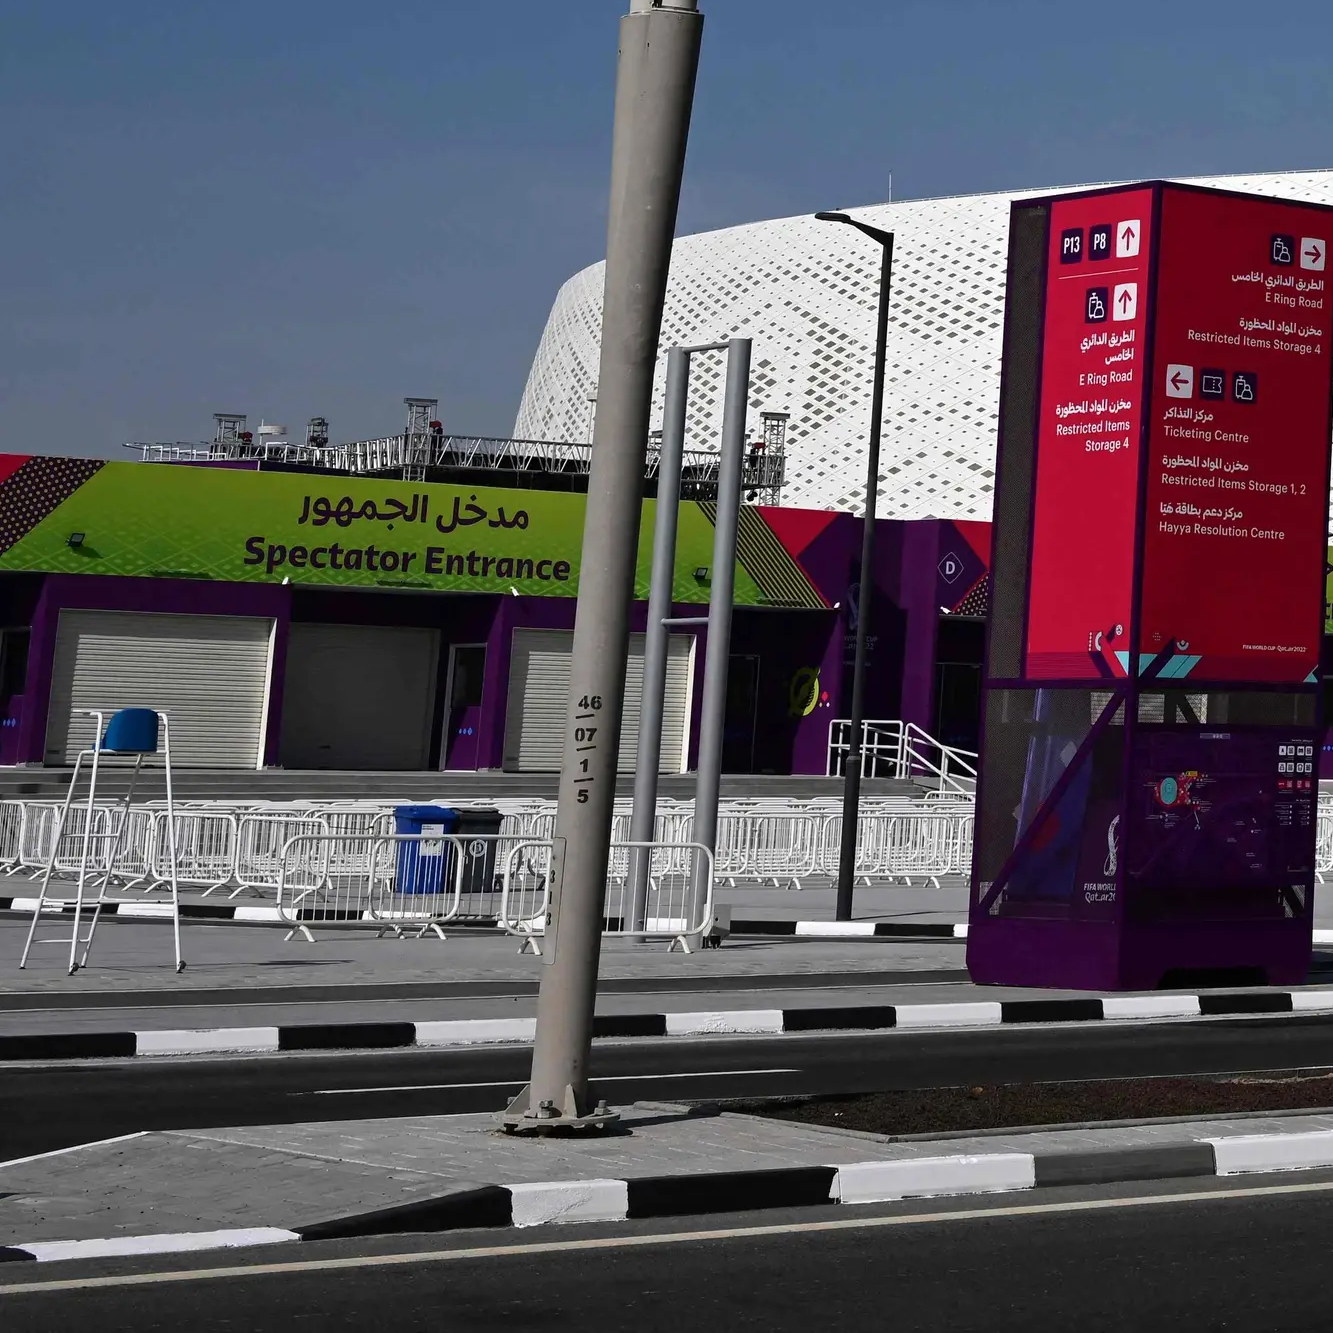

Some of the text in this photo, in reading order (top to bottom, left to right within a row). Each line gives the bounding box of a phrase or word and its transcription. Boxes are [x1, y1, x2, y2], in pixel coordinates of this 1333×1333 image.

[1063, 232, 1106, 254] P13 P8
[1231, 271, 1324, 292] الطريق الدائري الخامس
[1265, 292, 1323, 309] E Ring Road
[1239, 317, 1323, 338] مخزن المواد المحظورة
[1080, 329, 1135, 354] الطريق الدائري
[1187, 329, 1322, 355] Restricted Items Storage 4
[1104, 348, 1134, 366] الخامس
[1079, 369, 1133, 387] E Ring Road
[1055, 398, 1132, 419] مخزن المواد المحظورة
[1163, 406, 1214, 423] مركز التذاكر
[1056, 418, 1130, 437] Restricted Items
[1163, 425, 1250, 443] Ticketing Centre
[1085, 436, 1130, 454] Storage 4
[1162, 454, 1249, 474] مخزن المواد المحظورة
[1161, 473, 1306, 496] Restricted Items Storage 1, 2
[298, 492, 530, 534] مدخل الجمهور
[1175, 502, 1201, 518] بطاقة
[1202, 507, 1223, 520] دعم
[1223, 507, 1243, 521] مركز
[1159, 521, 1285, 540] Hayya Resolution Centre
[243, 535, 571, 581] Spectator Entrance
[945, 560, 956, 575] D
[577, 695, 603, 710] 46
[579, 758, 589, 773] 1
[576, 789, 589, 804] 5
[1083, 883, 1117, 891] FIFA WORL
